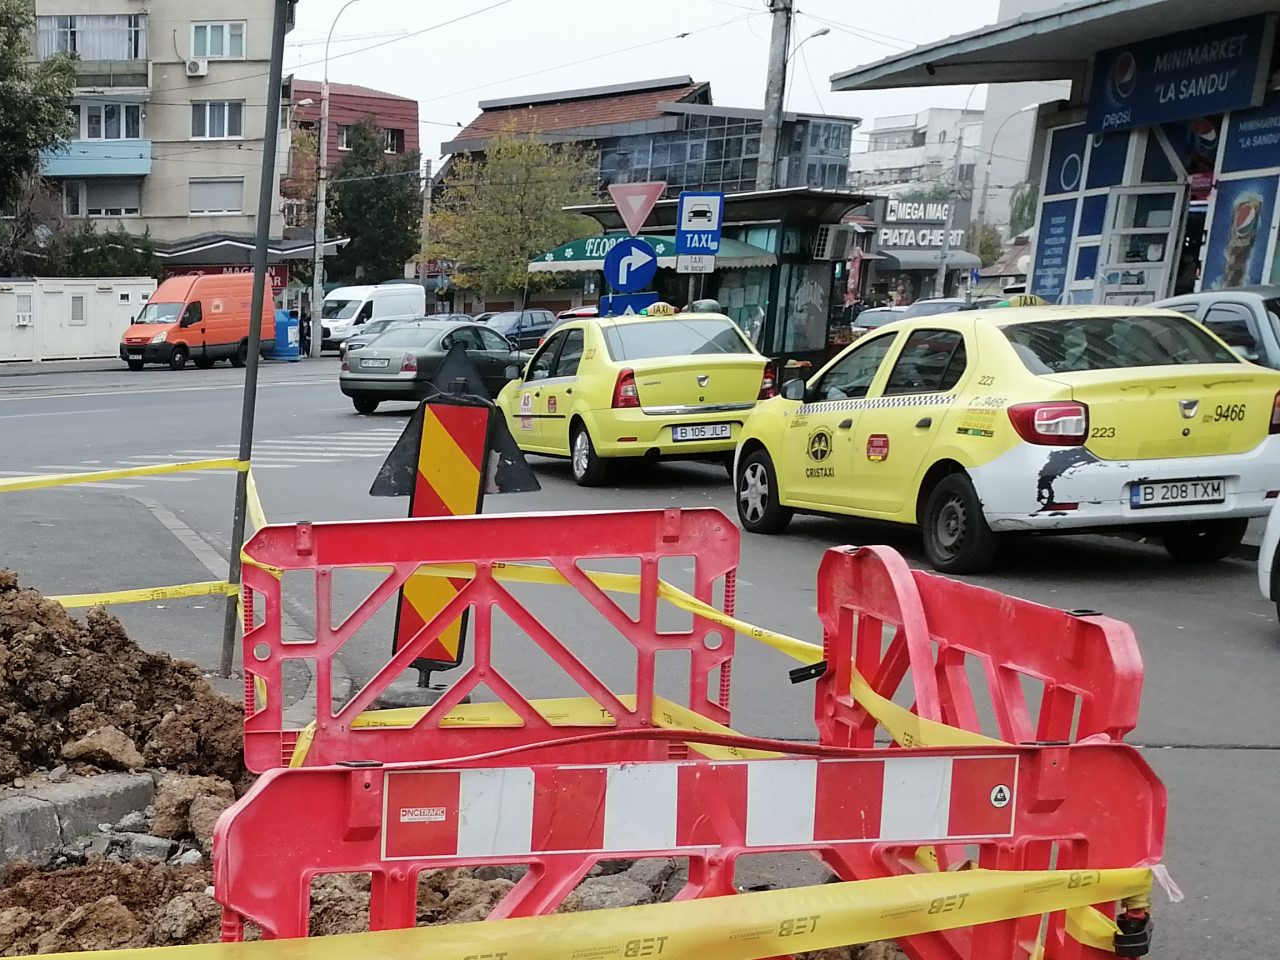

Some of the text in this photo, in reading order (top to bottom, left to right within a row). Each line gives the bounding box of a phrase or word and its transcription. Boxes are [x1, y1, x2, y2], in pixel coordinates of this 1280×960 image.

[1154, 35, 1247, 72] MINIMARKET
[1102, 107, 1131, 129] pepsi
[898, 203, 949, 220] MEGA IMAG
[686, 234, 712, 248] TAXI
[879, 229, 916, 246] PIATA
[690, 256, 704, 264] TAXI
[1019, 295, 1037, 307] TAXI
[653, 304, 668, 314] TAXI
[978, 375, 995, 387] 223
[1214, 404, 1246, 422] 9466
[680, 425, 728, 438] B 105 JLP
[1091, 427, 1116, 438] 223
[806, 467, 835, 478] CRISTAXI
[1144, 482, 1221, 501] B 208 TXM
